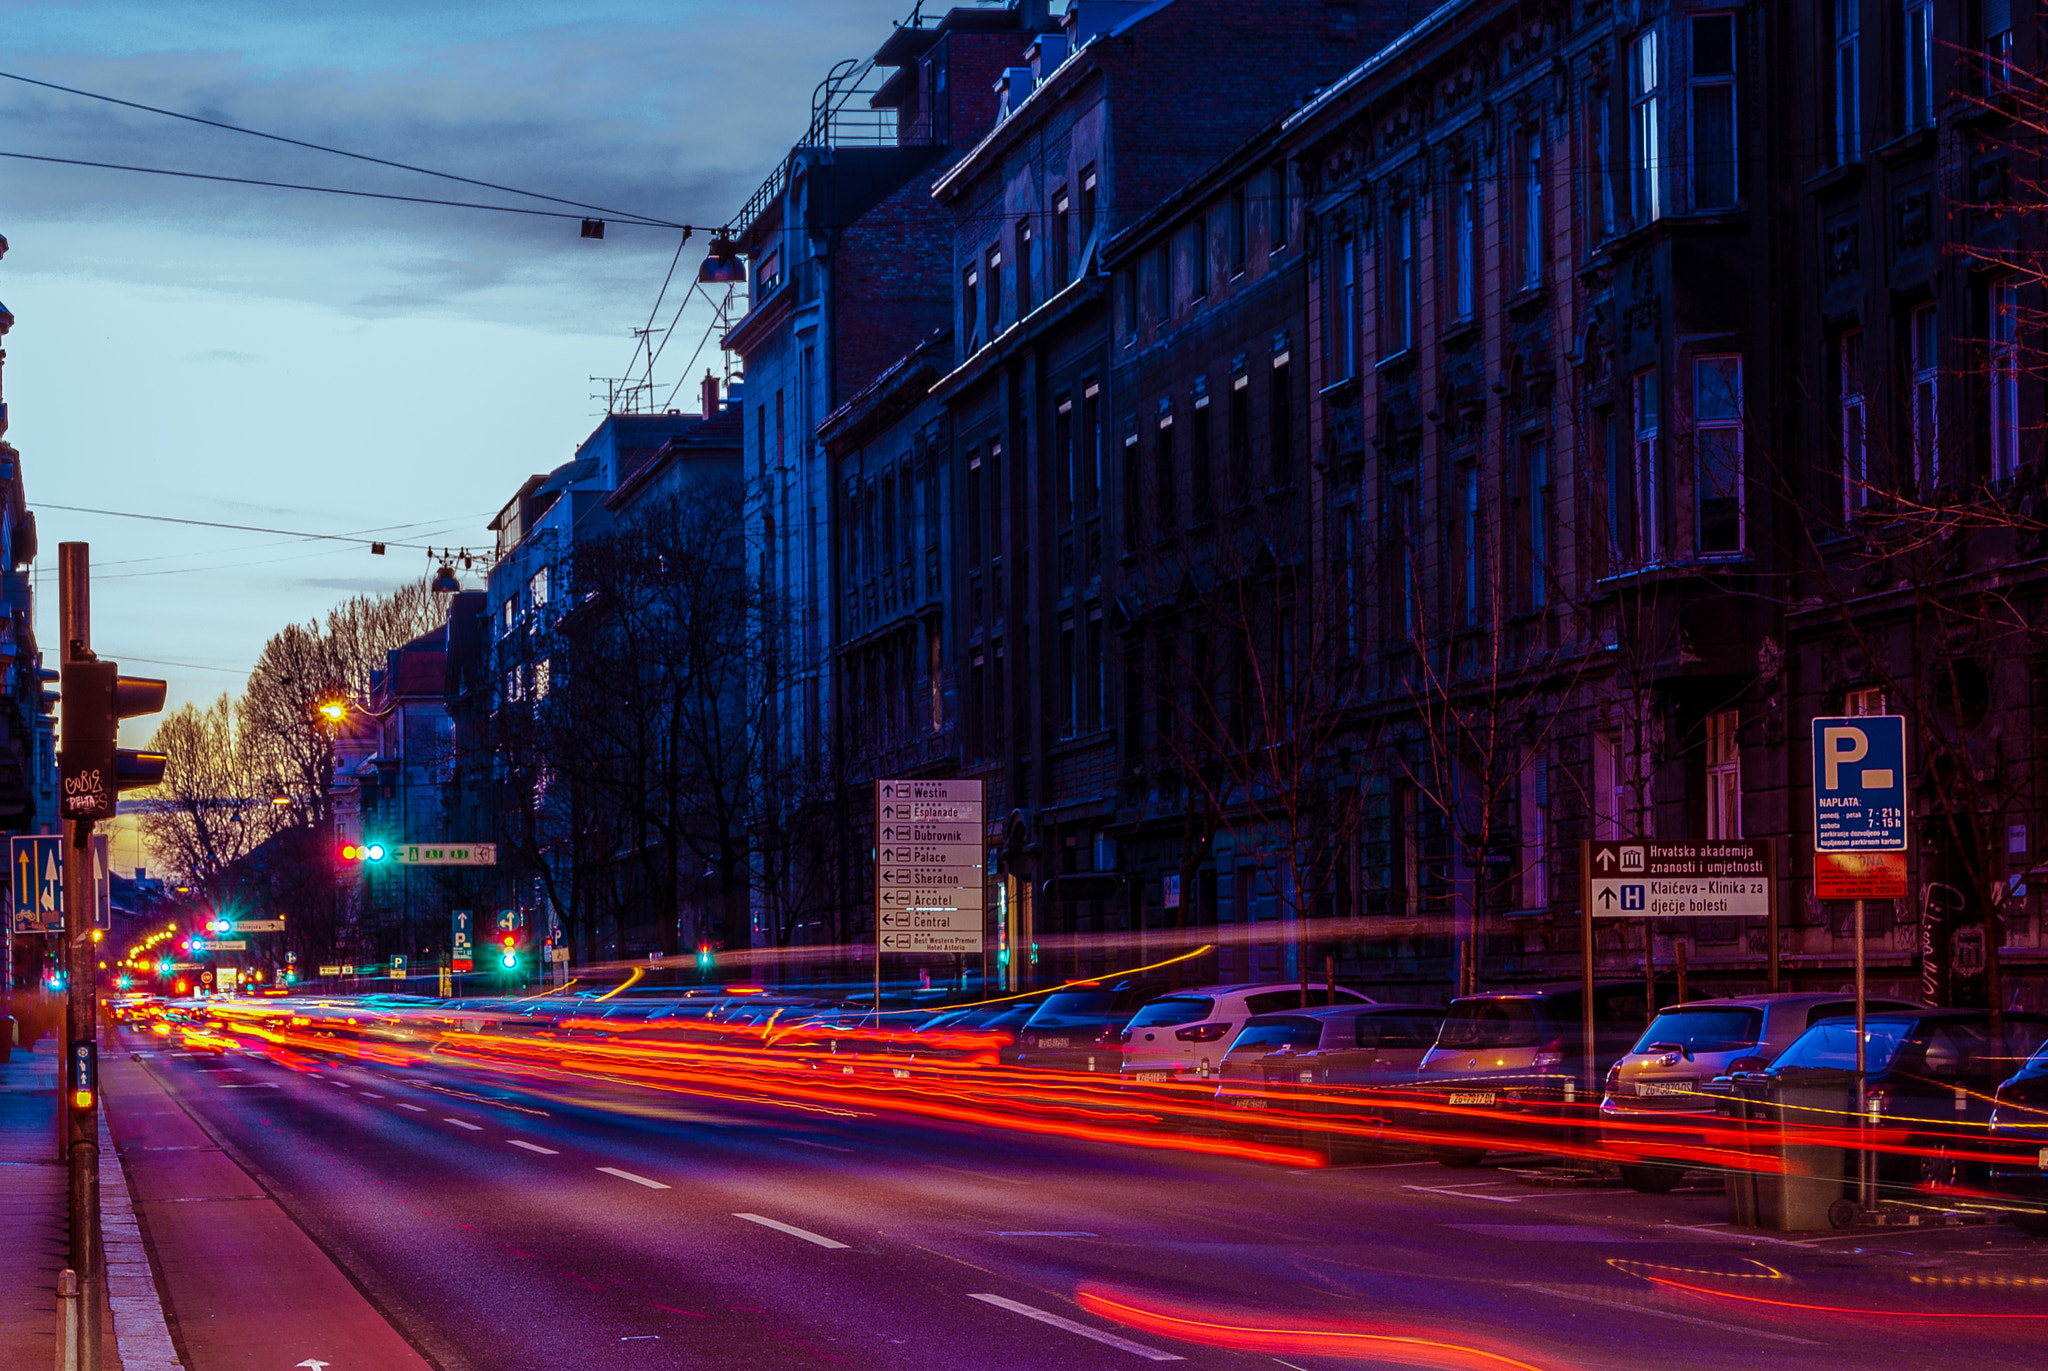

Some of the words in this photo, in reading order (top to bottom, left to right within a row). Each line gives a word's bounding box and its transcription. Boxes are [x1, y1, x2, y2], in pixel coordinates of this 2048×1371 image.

[1824, 726, 1868, 790] P
[914, 787, 947, 798] Westin
[1819, 797, 1862, 808] NAPLATA:
[914, 807, 958, 818] Esplanade
[1846, 811, 1861, 819] petak
[1868, 809, 1873, 817] 7
[1881, 808, 1893, 817] 21
[1895, 808, 1901, 817] h
[1868, 819, 1873, 828] 7
[1882, 818, 1893, 828] 15
[1895, 818, 1901, 828] h
[914, 830, 962, 841] Dubrovnik
[914, 852, 946, 862] Palace
[1650, 845, 1696, 857] Hrvatska
[1700, 845, 1754, 860] akademija
[1651, 861, 1696, 873] znanosti
[1699, 861, 1703, 873] i
[1707, 860, 1763, 875] umjetnosti
[914, 873, 959, 884] Sheraton
[1651, 881, 1697, 894] Klaićeva
[1708, 881, 1746, 894] Klinika
[1750, 883, 1763, 894] za
[1836, 886, 1873, 896] m-parking
[914, 895, 952, 905] Arcotel
[1651, 899, 1685, 914] dječje
[1690, 899, 1727, 911] bolesti
[914, 916, 950, 927] Central
[455, 932, 466, 947] P
